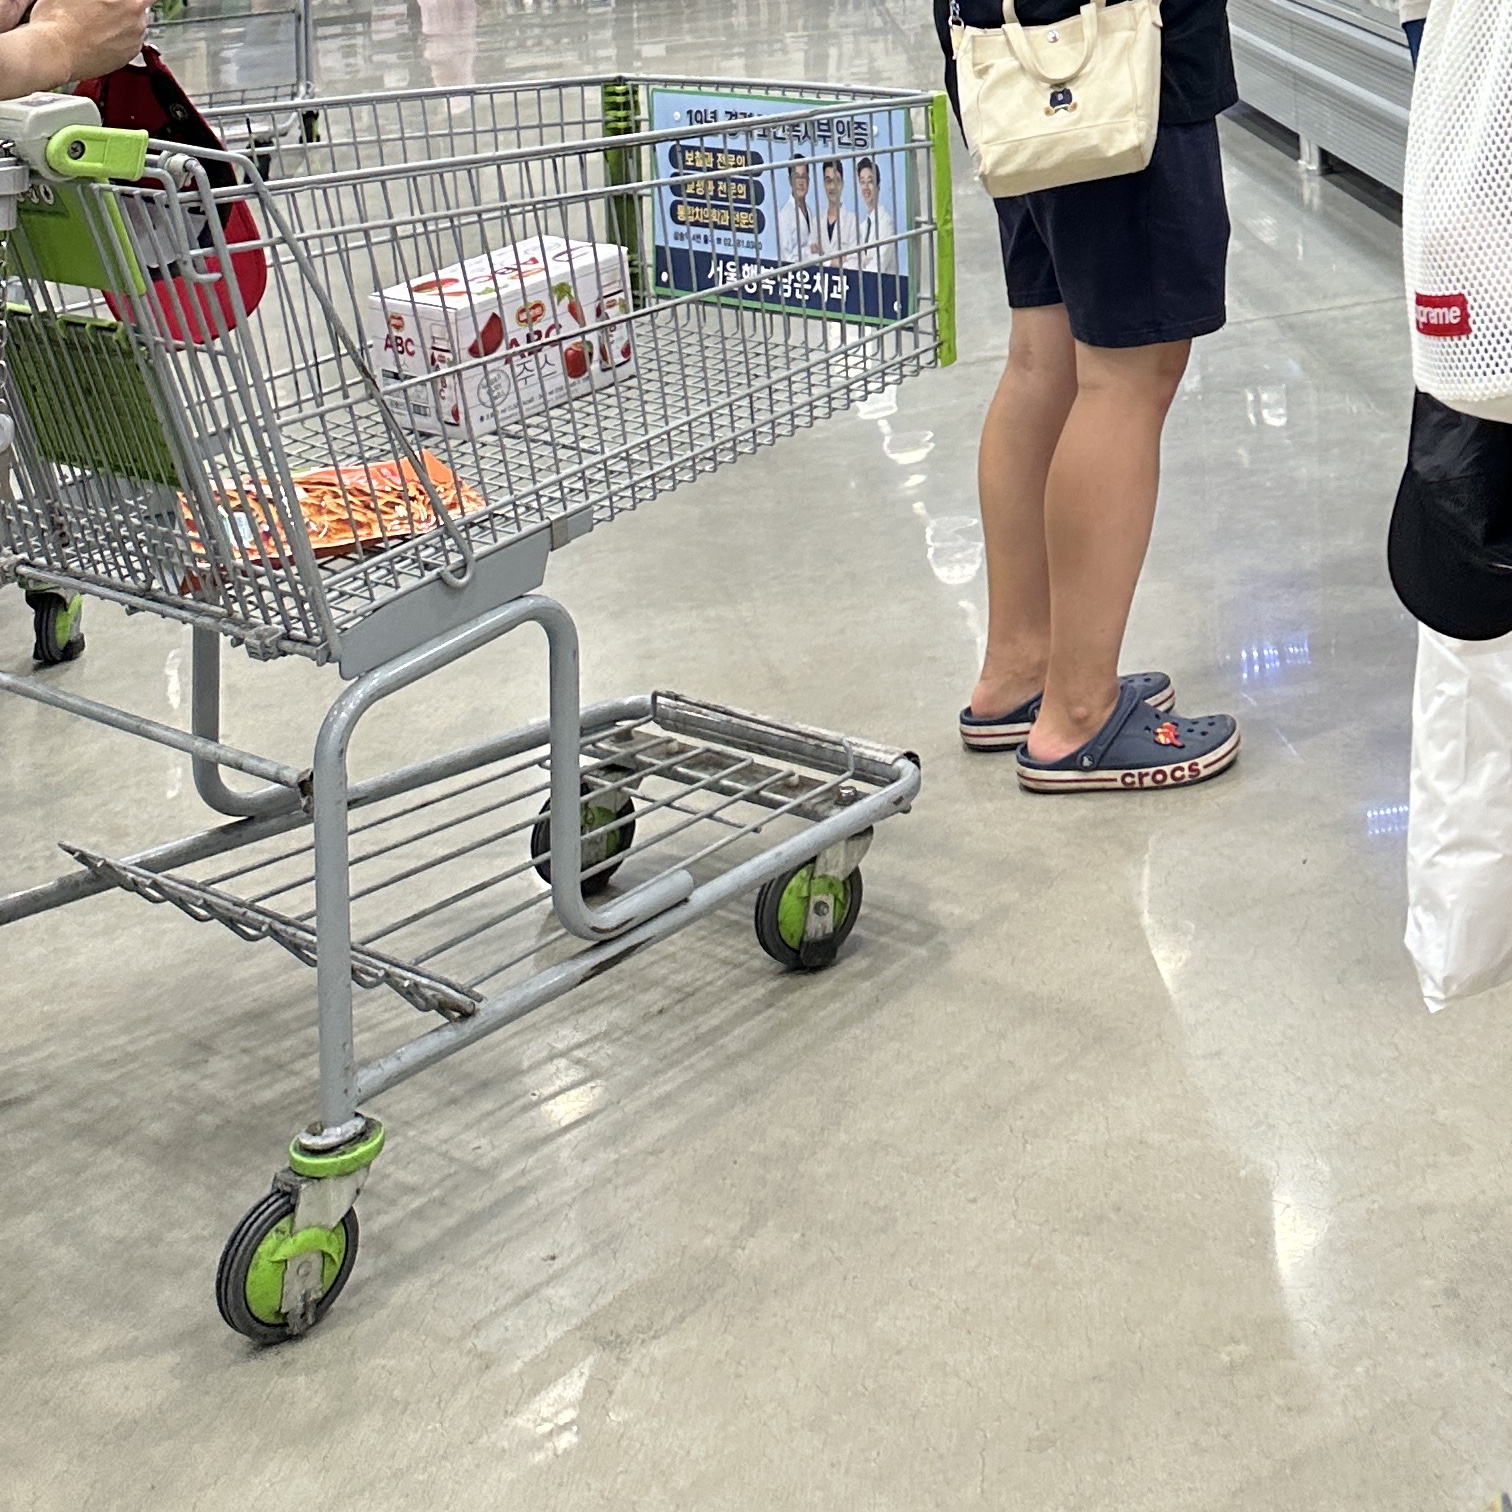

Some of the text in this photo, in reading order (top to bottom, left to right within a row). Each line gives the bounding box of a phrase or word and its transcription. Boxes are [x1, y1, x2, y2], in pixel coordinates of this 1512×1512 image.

[384, 333, 415, 356] ABC
[516, 354, 557, 385] 주스
[1120, 760, 1201, 788] crocs
